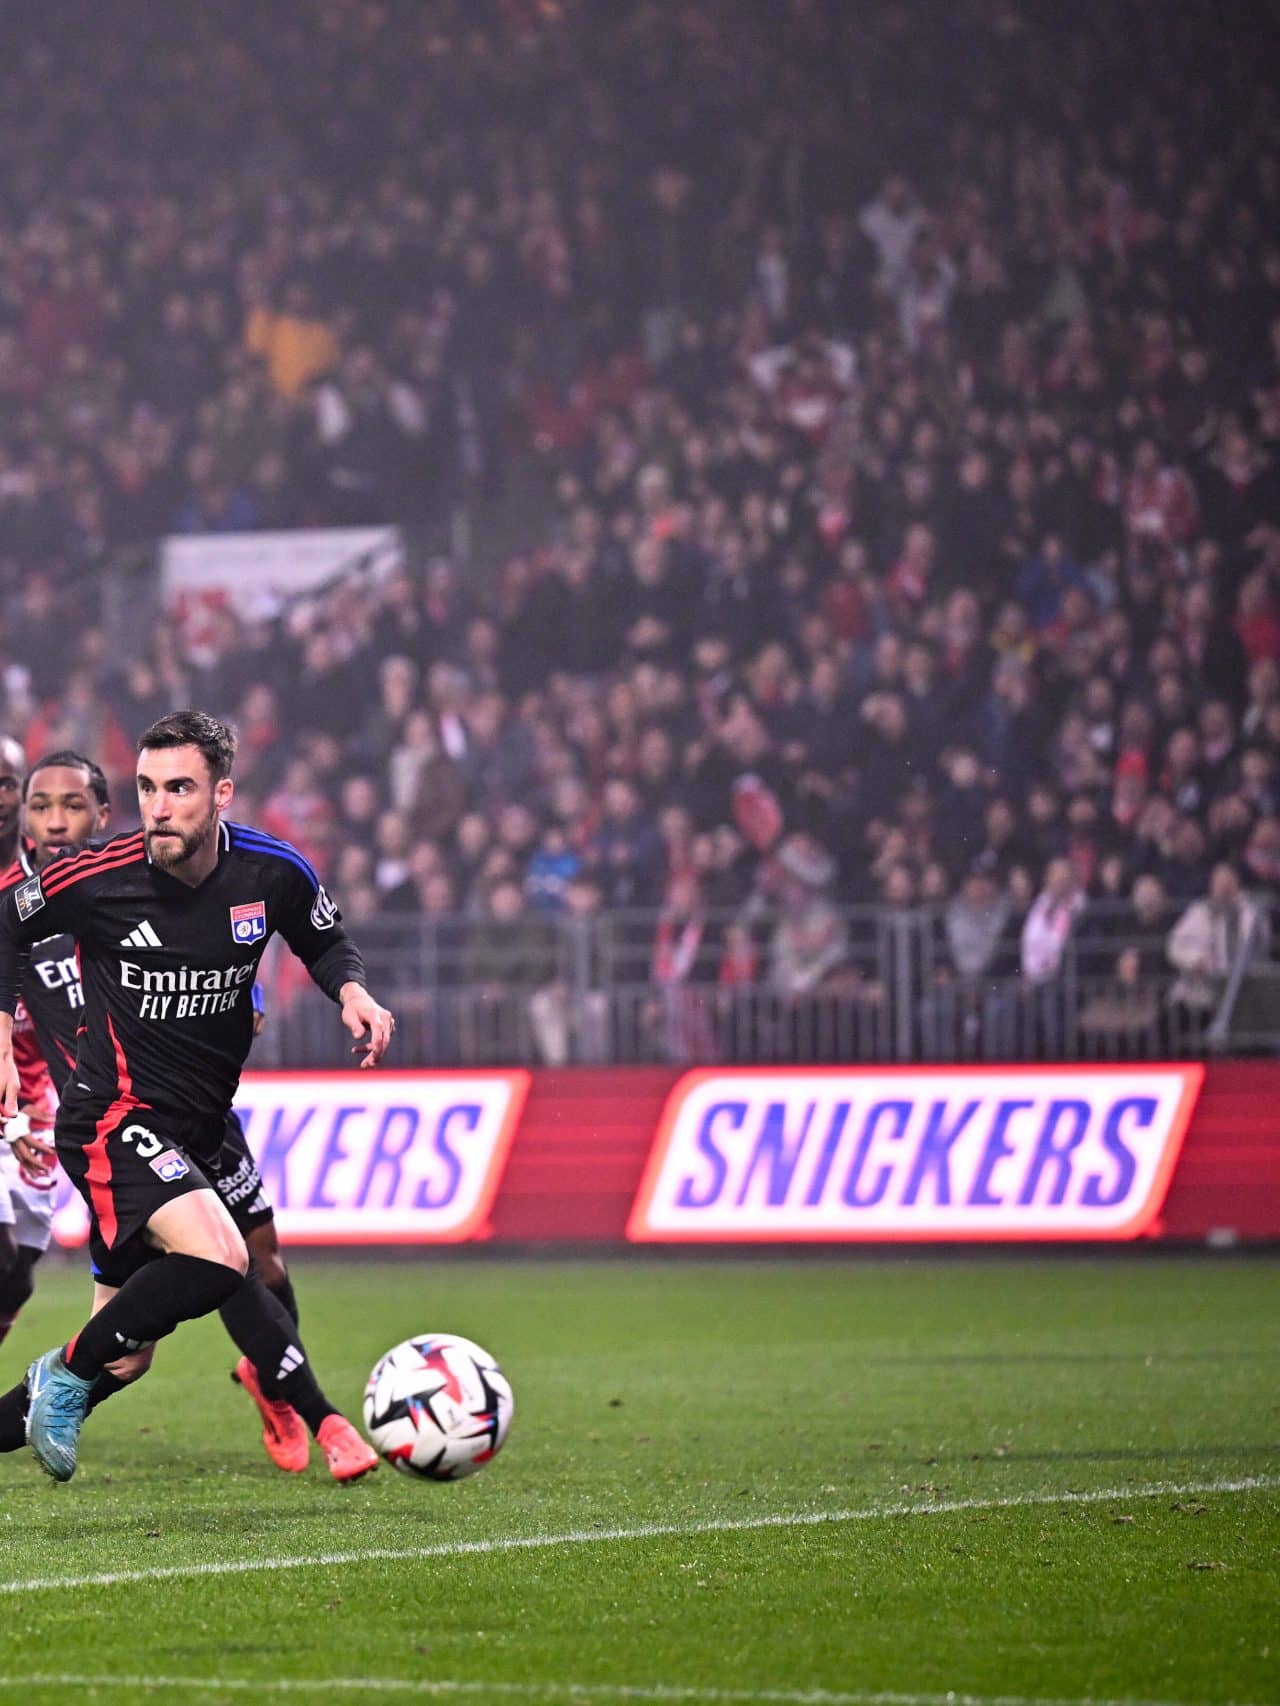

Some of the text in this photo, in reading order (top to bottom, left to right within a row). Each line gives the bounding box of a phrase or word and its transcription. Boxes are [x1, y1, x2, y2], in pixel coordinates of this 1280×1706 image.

[139, 989, 240, 1020] FLY BETTER
[122, 1124, 164, 1158] 3
[229, 1104, 483, 1210] KERS
[674, 1097, 1159, 1209] SNICKERS
[217, 1156, 251, 1193] Staff
